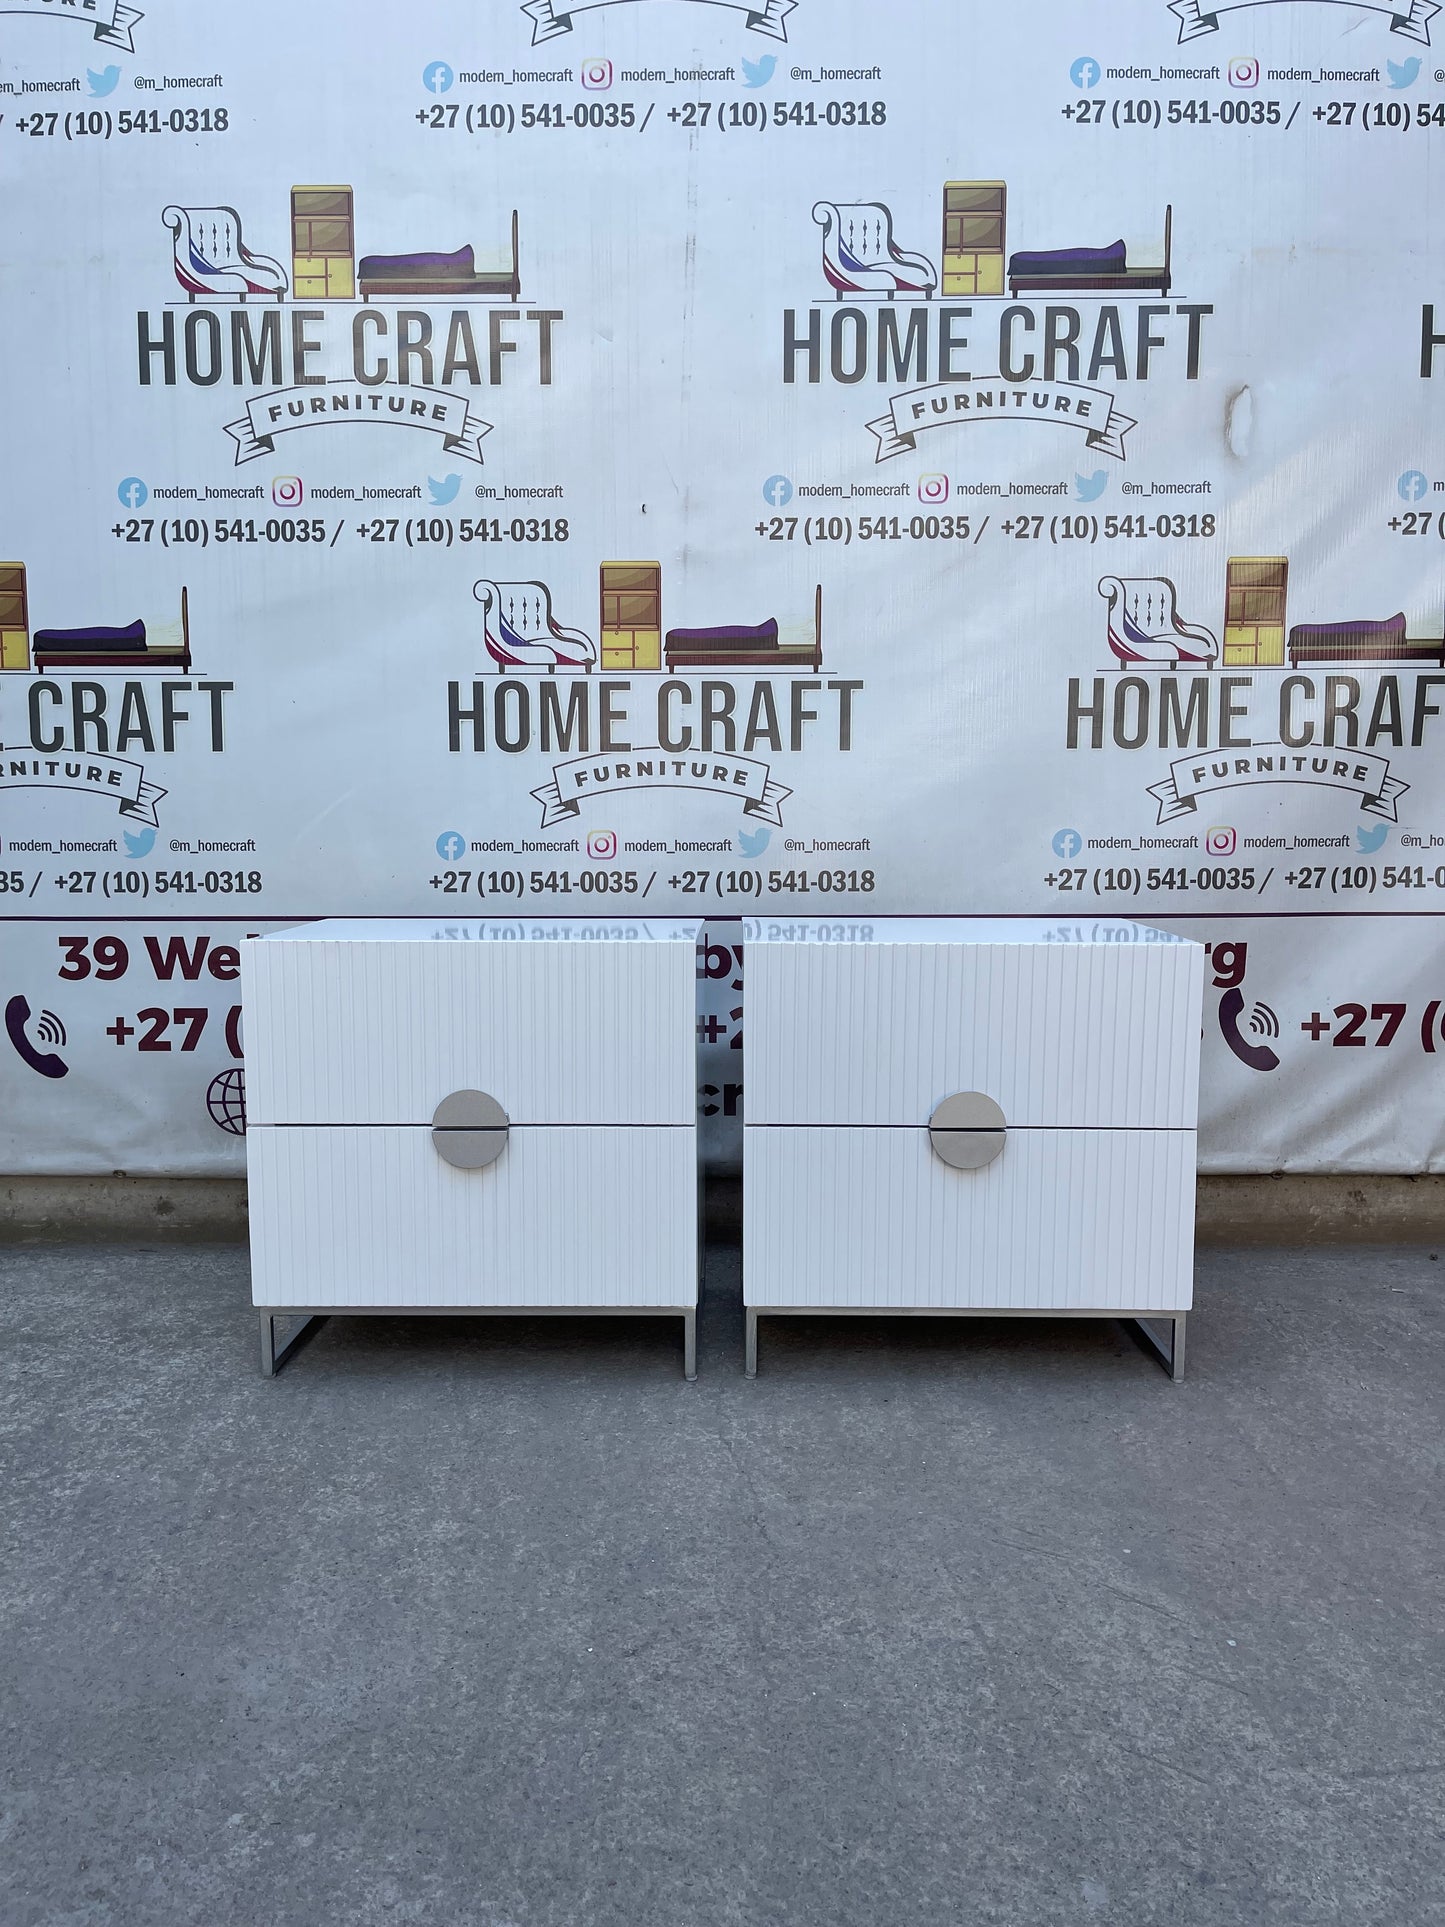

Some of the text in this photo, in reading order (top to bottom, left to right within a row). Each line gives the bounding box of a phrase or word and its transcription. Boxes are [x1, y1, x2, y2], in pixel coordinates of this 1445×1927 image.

[134, 74, 223, 92] @m_homecraft
[790, 66, 882, 83] @m_homecraft
[15, 112, 59, 137] +27
[118, 107, 229, 134] 541-0318
[415, 104, 460, 129] +27
[520, 102, 636, 128] 541-0035
[667, 102, 712, 127] +27
[773, 101, 887, 127] 541-0318
[1061, 99, 1106, 124] +27
[1167, 99, 1281, 125] 541-0035
[1312, 101, 1357, 126] +27
[137, 309, 564, 386] HOME CRAFT
[783, 304, 1214, 384] HOME CRAFT
[268, 394, 448, 423] FURNITURE
[911, 391, 1093, 419] FURNITURE
[475, 484, 564, 501] @m_homecraft
[1121, 480, 1212, 497] @m_homecraft
[111, 519, 155, 542] +27
[214, 519, 326, 543] 541-0035
[356, 519, 400, 542] +27
[459, 518, 569, 542] 541-0318
[754, 516, 799, 541] +27
[858, 515, 970, 540] 541-0035
[1000, 515, 1045, 539] +27
[1103, 513, 1216, 539] 541-0318
[28, 680, 234, 752] CRAFT
[447, 679, 864, 752] HOME CRAFT
[1066, 676, 1253, 749] HOME
[574, 760, 749, 787] FURNITURE
[1192, 756, 1368, 784] FURNITURE
[169, 838, 256, 854] @m_homecraft
[784, 838, 871, 854] @m_homecraft
[54, 871, 97, 893] +27
[154, 870, 263, 894] 541-0318
[429, 870, 472, 893] +27
[529, 870, 638, 894] 541-0035
[668, 870, 710, 893] +27
[767, 869, 875, 893] 541-0318
[1043, 868, 1088, 891] +27
[1146, 867, 1255, 891] 541-0035
[1284, 866, 1327, 889] +27
[58, 935, 129, 981] 39
[106, 1007, 209, 1052] +27
[1301, 1002, 1407, 1047] +27
